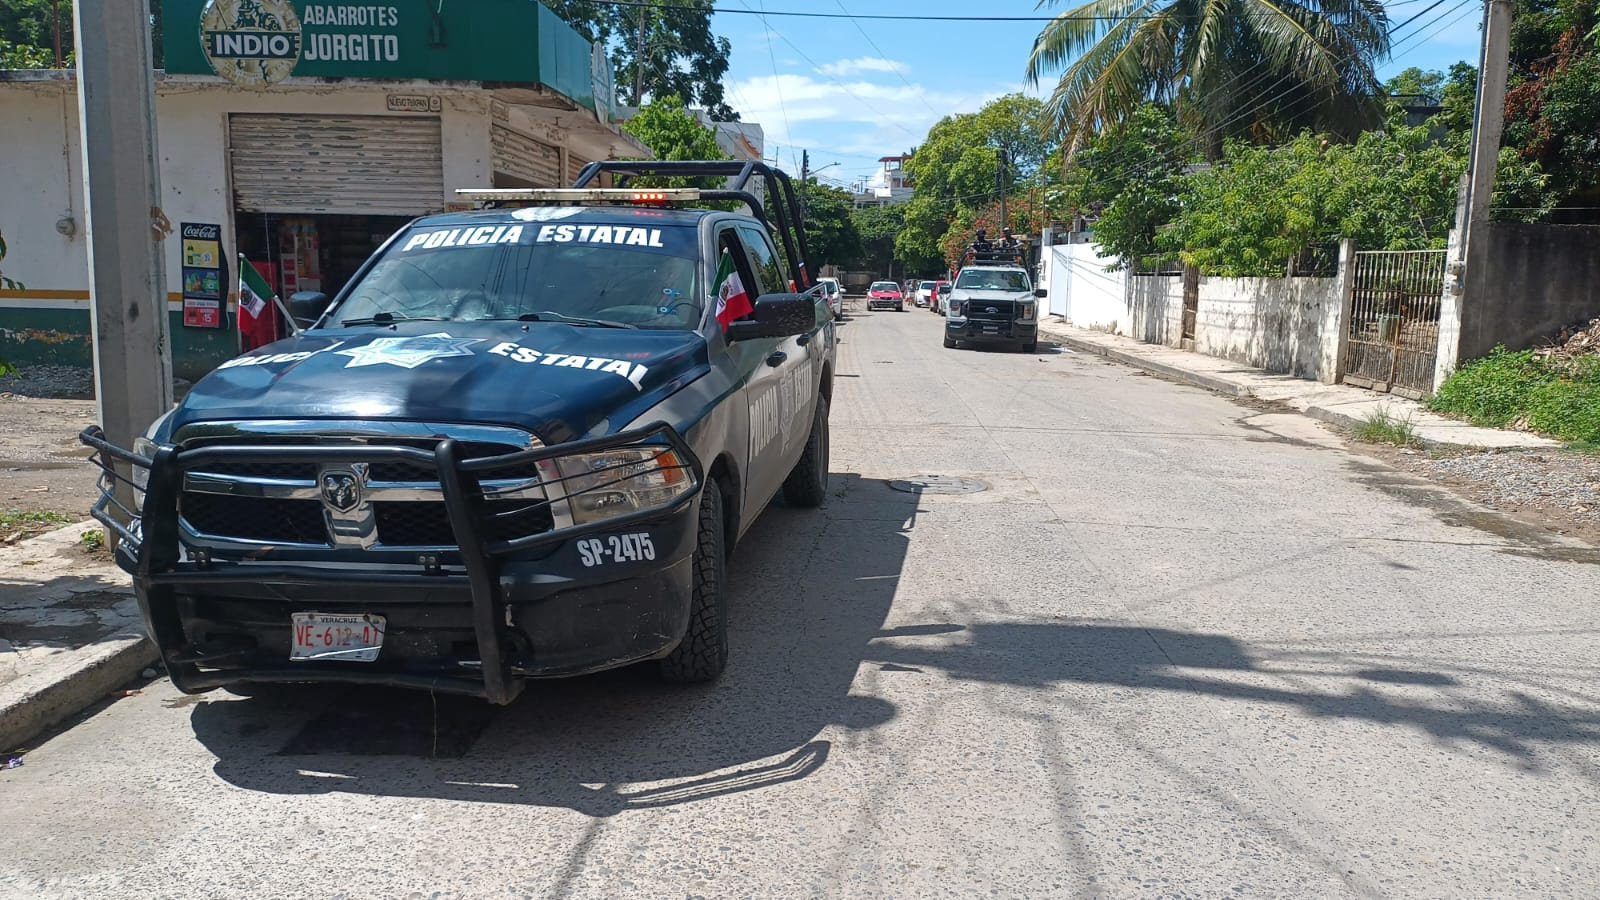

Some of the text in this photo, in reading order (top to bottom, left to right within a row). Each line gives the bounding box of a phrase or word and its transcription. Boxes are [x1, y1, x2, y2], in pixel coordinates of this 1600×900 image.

[304, 5, 398, 27] ABARROTES
[215, 34, 290, 56] INDIO
[304, 33, 399, 62] JORGITO
[402, 225, 664, 252] POLICIA ESTATAL
[488, 342, 649, 392] ESTATAL
[749, 385, 779, 463] POLICIA
[577, 532, 655, 567] SP-2475
